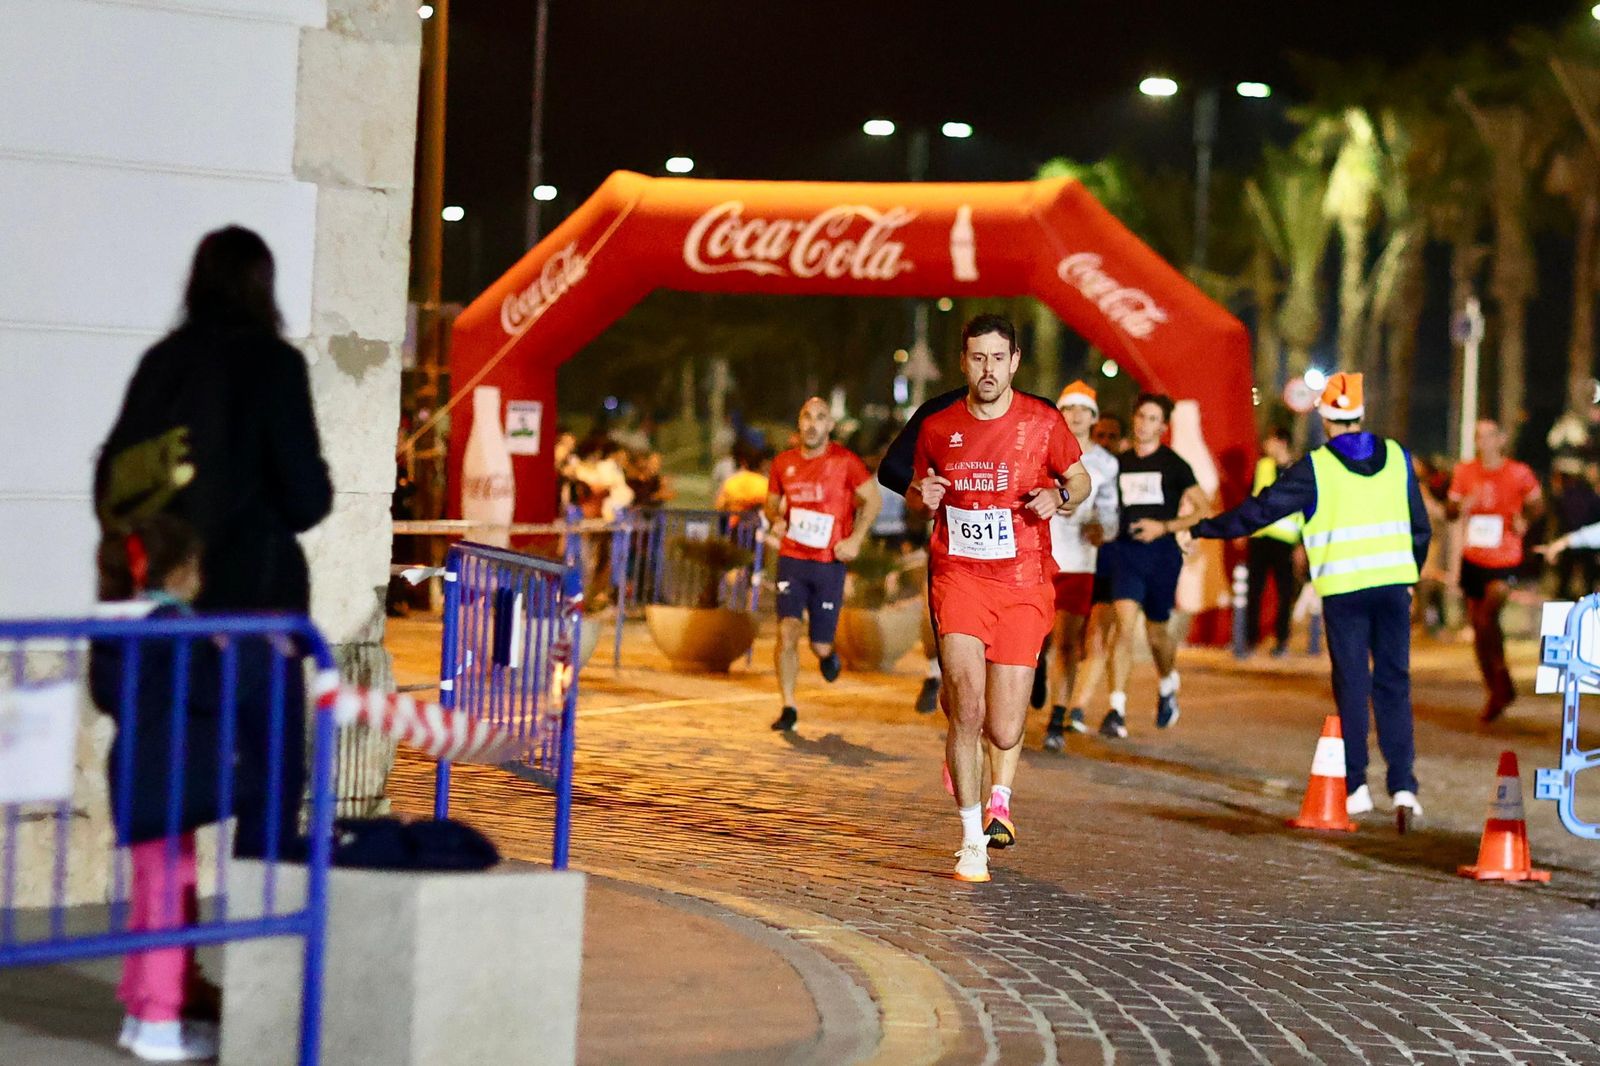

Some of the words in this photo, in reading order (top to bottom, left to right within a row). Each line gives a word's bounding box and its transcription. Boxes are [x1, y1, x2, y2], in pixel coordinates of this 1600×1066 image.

[683, 200, 920, 281] Coca-Cola
[954, 461, 994, 470] GENERALI
[954, 476, 995, 492] MÁLAGA
[984, 512, 994, 521] M
[961, 522, 993, 540] 631
